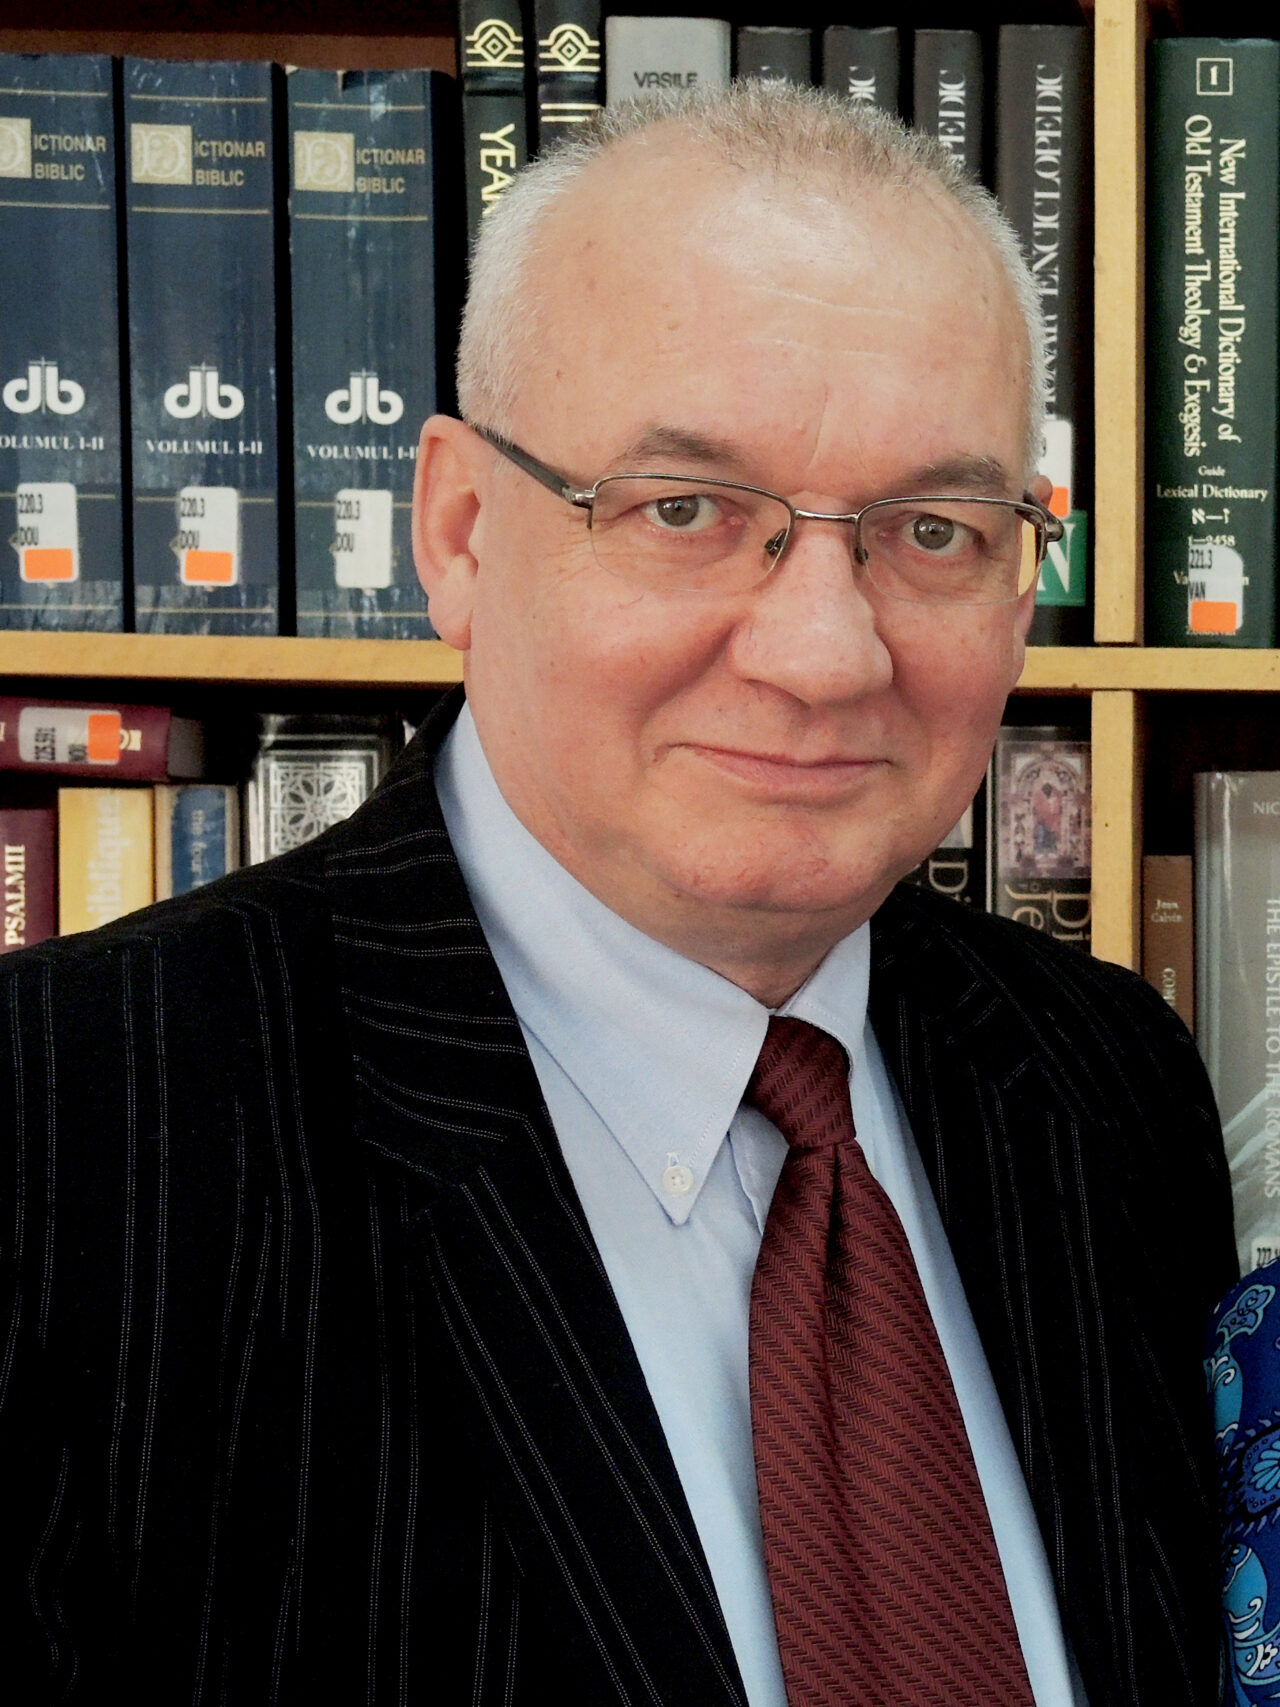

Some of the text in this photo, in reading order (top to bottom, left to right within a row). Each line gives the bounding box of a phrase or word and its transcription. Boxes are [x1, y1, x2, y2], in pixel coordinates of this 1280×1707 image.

[634, 72, 697, 89] VASILE
[1210, 65, 1219, 86] 1
[34, 163, 85, 181] BIBLIC
[194, 169, 244, 187] BIBLIC
[1032, 64, 1063, 297] ENCICLOPEDIC
[356, 177, 405, 194] BIBLIC
[1178, 114, 1212, 458] Old Testament Theology & Exegesis
[1212, 138, 1246, 443] New International Dictionary of
[0, 435, 74, 451] OLUMUL
[145, 440, 231, 455] VOLUMUL
[307, 444, 391, 460] VOLUMUL
[1198, 465, 1226, 477] Guide
[1157, 484, 1268, 502] Lexical Dictionary
[18, 494, 43, 514] 220.3
[181, 498, 205, 517] 220.3
[336, 501, 360, 520] 220.3
[18, 527, 39, 546] DOU
[181, 531, 199, 550] DOU
[336, 533, 354, 552] DOU
[1189, 550, 1213, 570] 221.3
[1188, 581, 1206, 600] VAN
